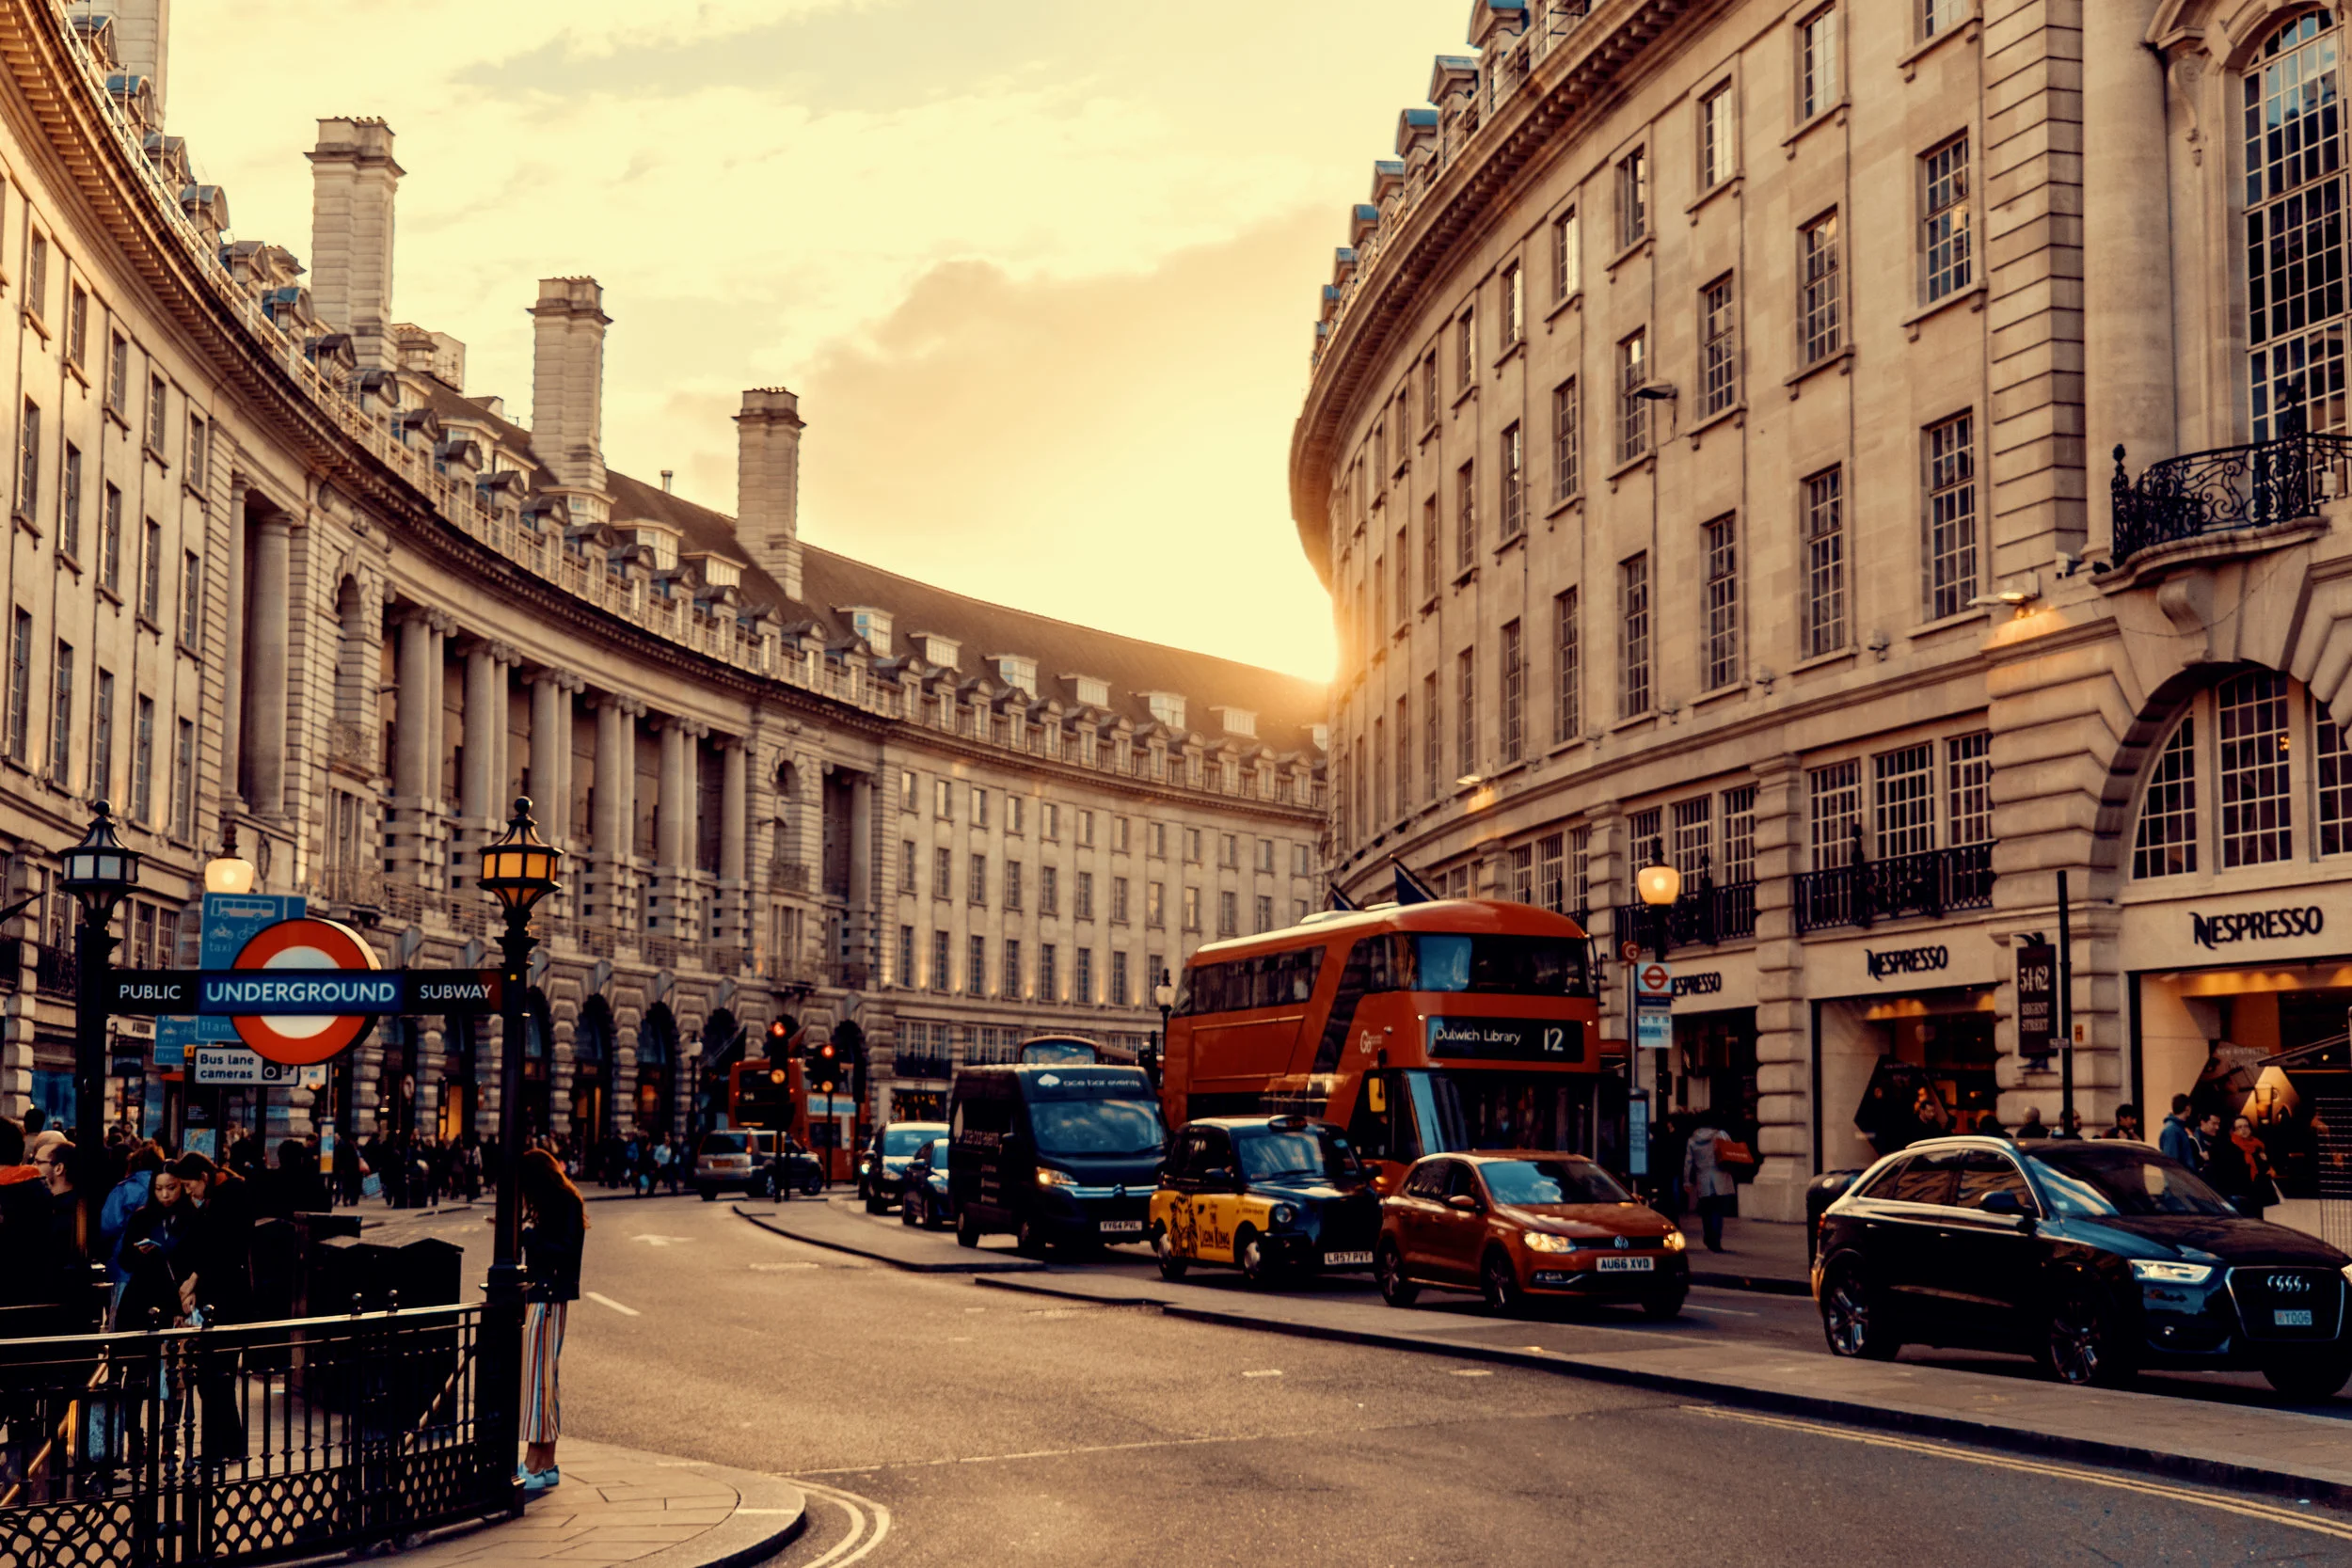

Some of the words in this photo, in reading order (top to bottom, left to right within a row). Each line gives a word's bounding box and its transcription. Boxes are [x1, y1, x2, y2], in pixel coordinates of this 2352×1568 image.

[2188, 905, 2324, 950] NESPRESSO
[209, 942, 231, 952] taxi
[1626, 944, 1637, 959] G
[1865, 945, 1948, 981] NESPRESSO
[119, 985, 182, 1000] PUBLIC
[206, 982, 396, 1003] UNDERGROUND
[420, 985, 493, 1000] SUBWAY
[1671, 972, 1722, 1002] ESPRESSO
[2021, 1019, 2049, 1032] STREET
[1435, 1027, 1480, 1041] Dulwich
[1484, 1029, 1521, 1045] Library
[1544, 1027, 1564, 1052] 12
[199, 1053, 224, 1066] Bus
[228, 1053, 254, 1066] lane
[199, 1069, 253, 1080] cameras
